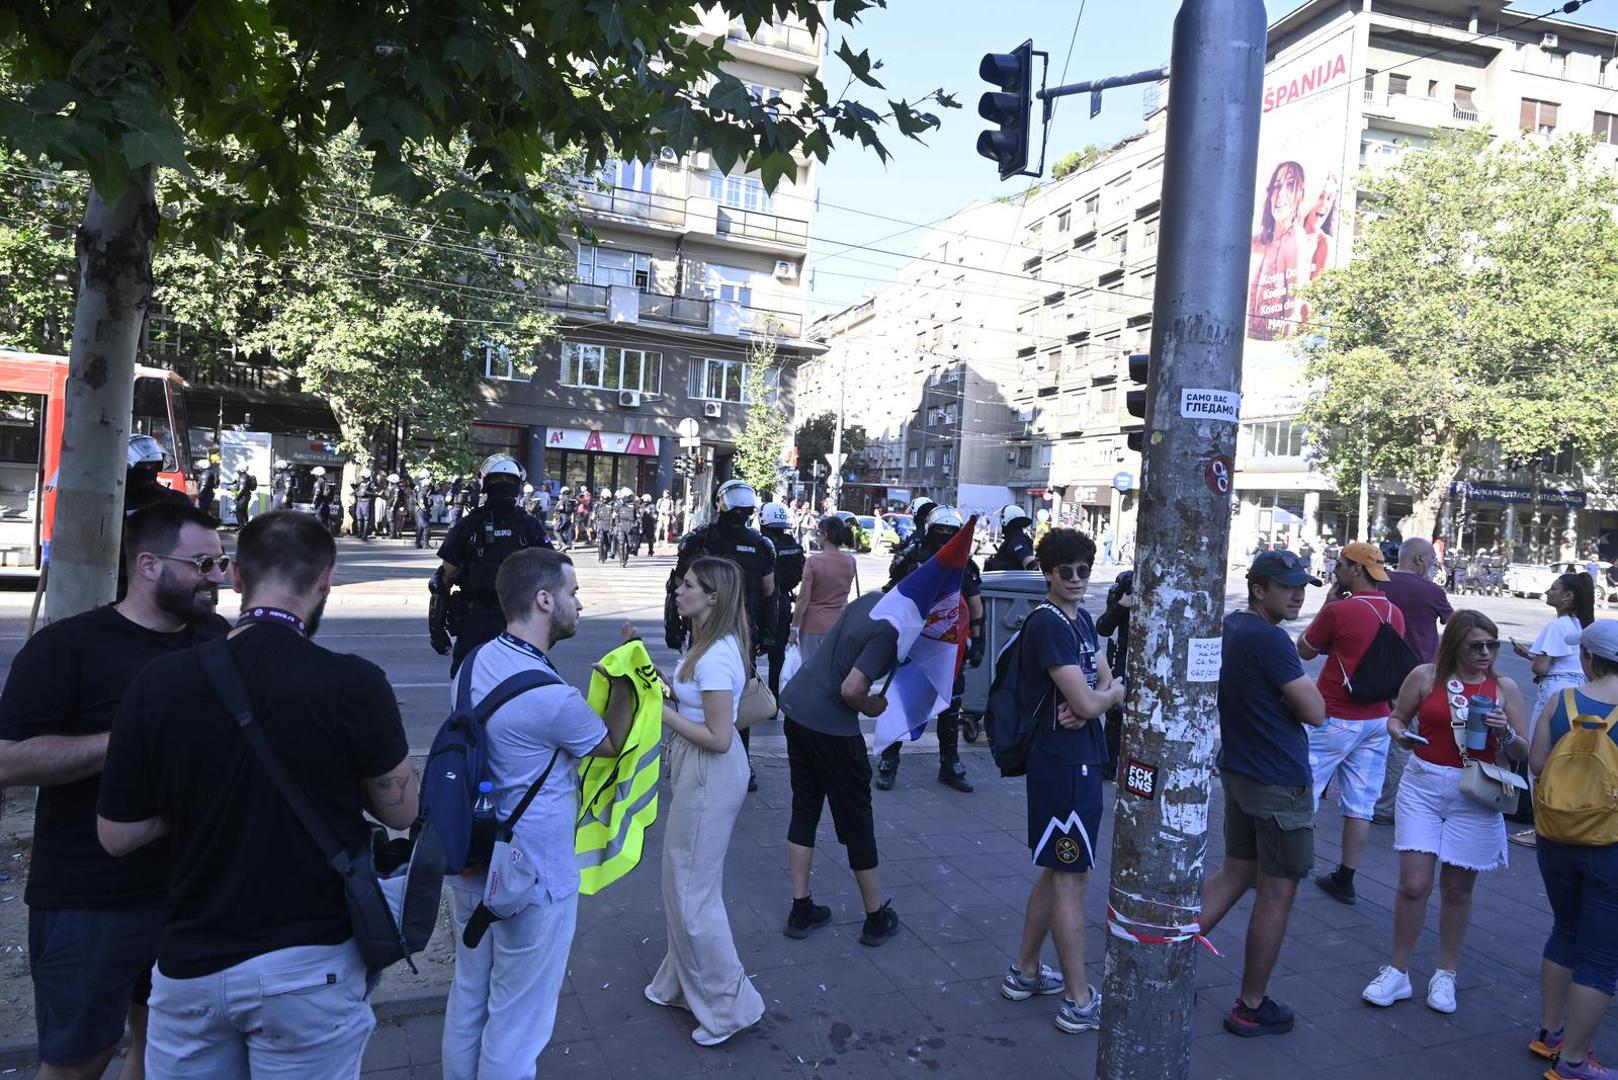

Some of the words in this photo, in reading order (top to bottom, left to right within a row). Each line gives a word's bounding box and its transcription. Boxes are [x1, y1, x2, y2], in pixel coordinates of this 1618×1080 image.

[1263, 54, 1346, 113] ŠPANIJA
[1186, 393, 1212, 402] САМО
[1213, 394, 1228, 403] ВАС
[1186, 402, 1234, 415] ГЛЕДАМО
[1129, 764, 1153, 783] FCK
[1127, 775, 1153, 793] SNS
